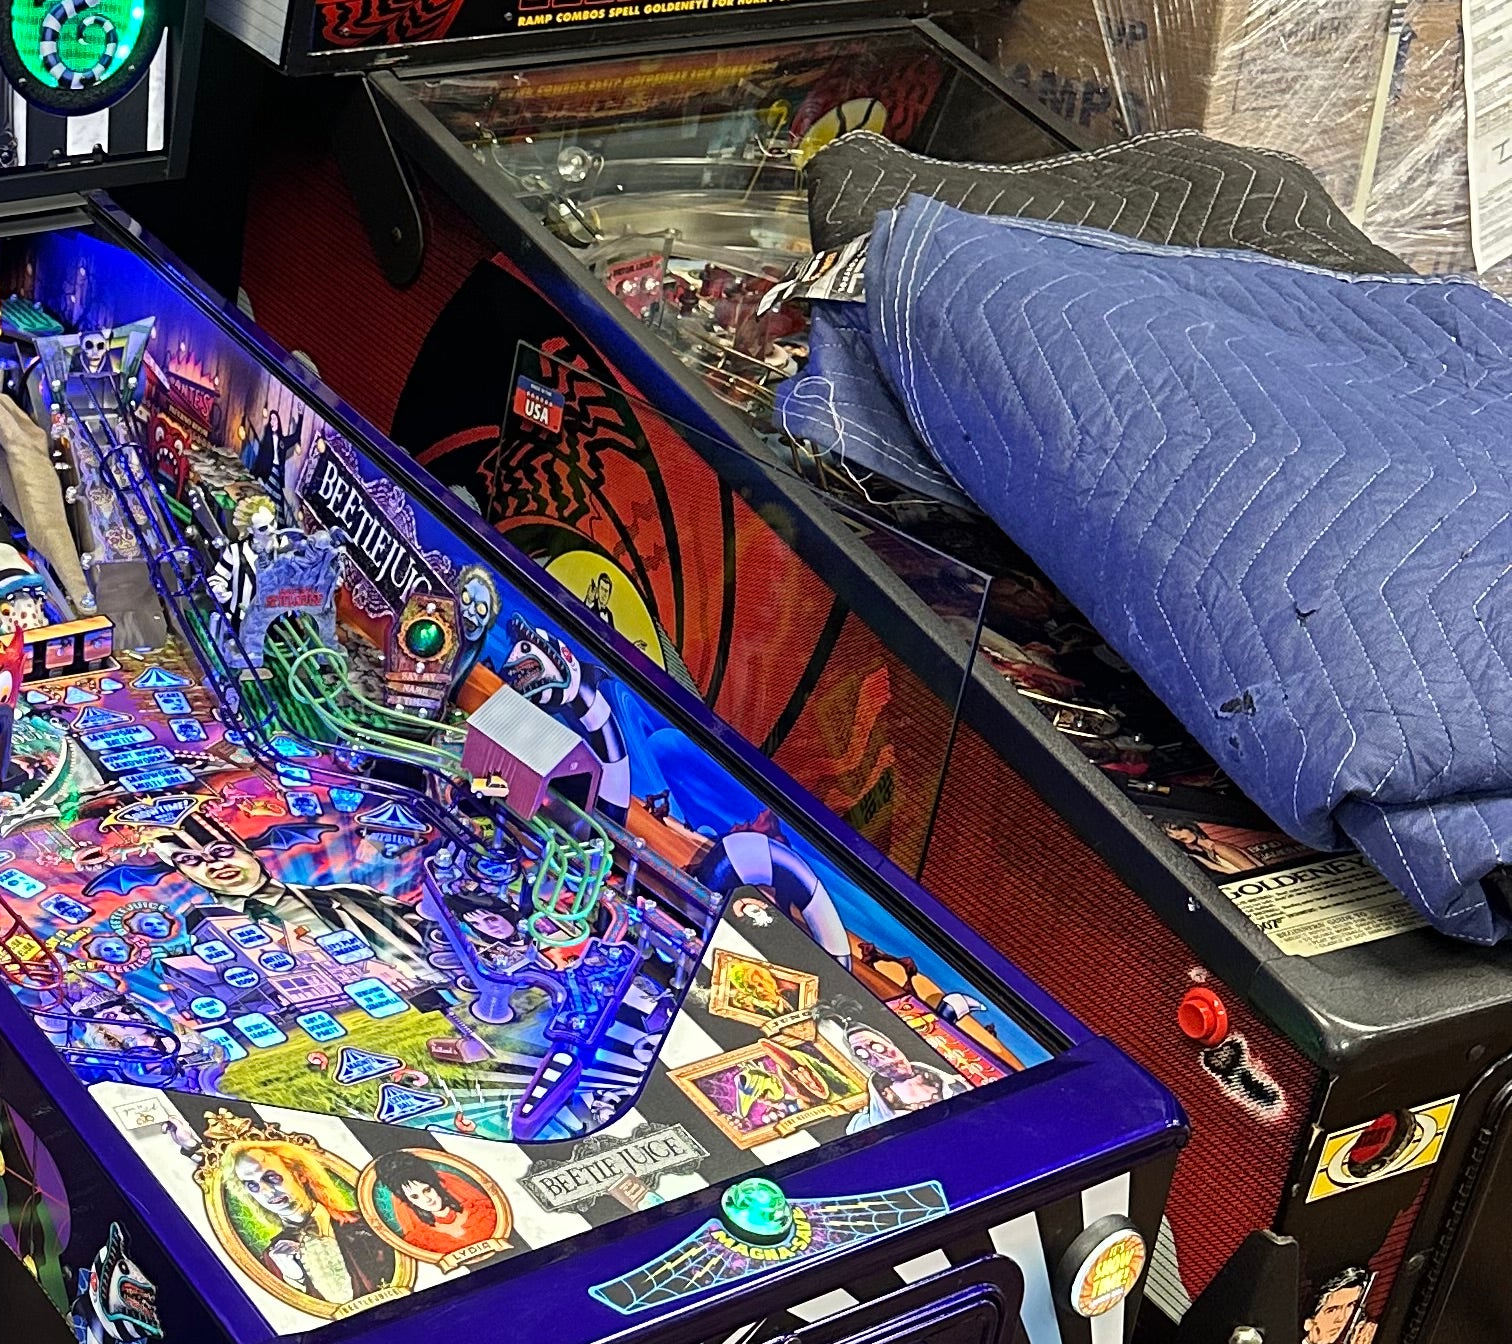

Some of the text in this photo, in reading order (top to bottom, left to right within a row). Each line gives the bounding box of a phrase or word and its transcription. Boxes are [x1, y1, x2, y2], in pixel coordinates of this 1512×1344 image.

[517, 14, 552, 27] RAMP
[555, 8, 606, 23] COMBOS
[608, 6, 641, 19] SPELL
[524, 399, 550, 426] USA
[368, 832, 416, 847] MYSTERY
[538, 1160, 622, 1199] BEETLE
[621, 1134, 688, 1176] JUICE
[712, 1206, 812, 1262] MAGNA-SAVE
[452, 1241, 492, 1262] LYDIA
